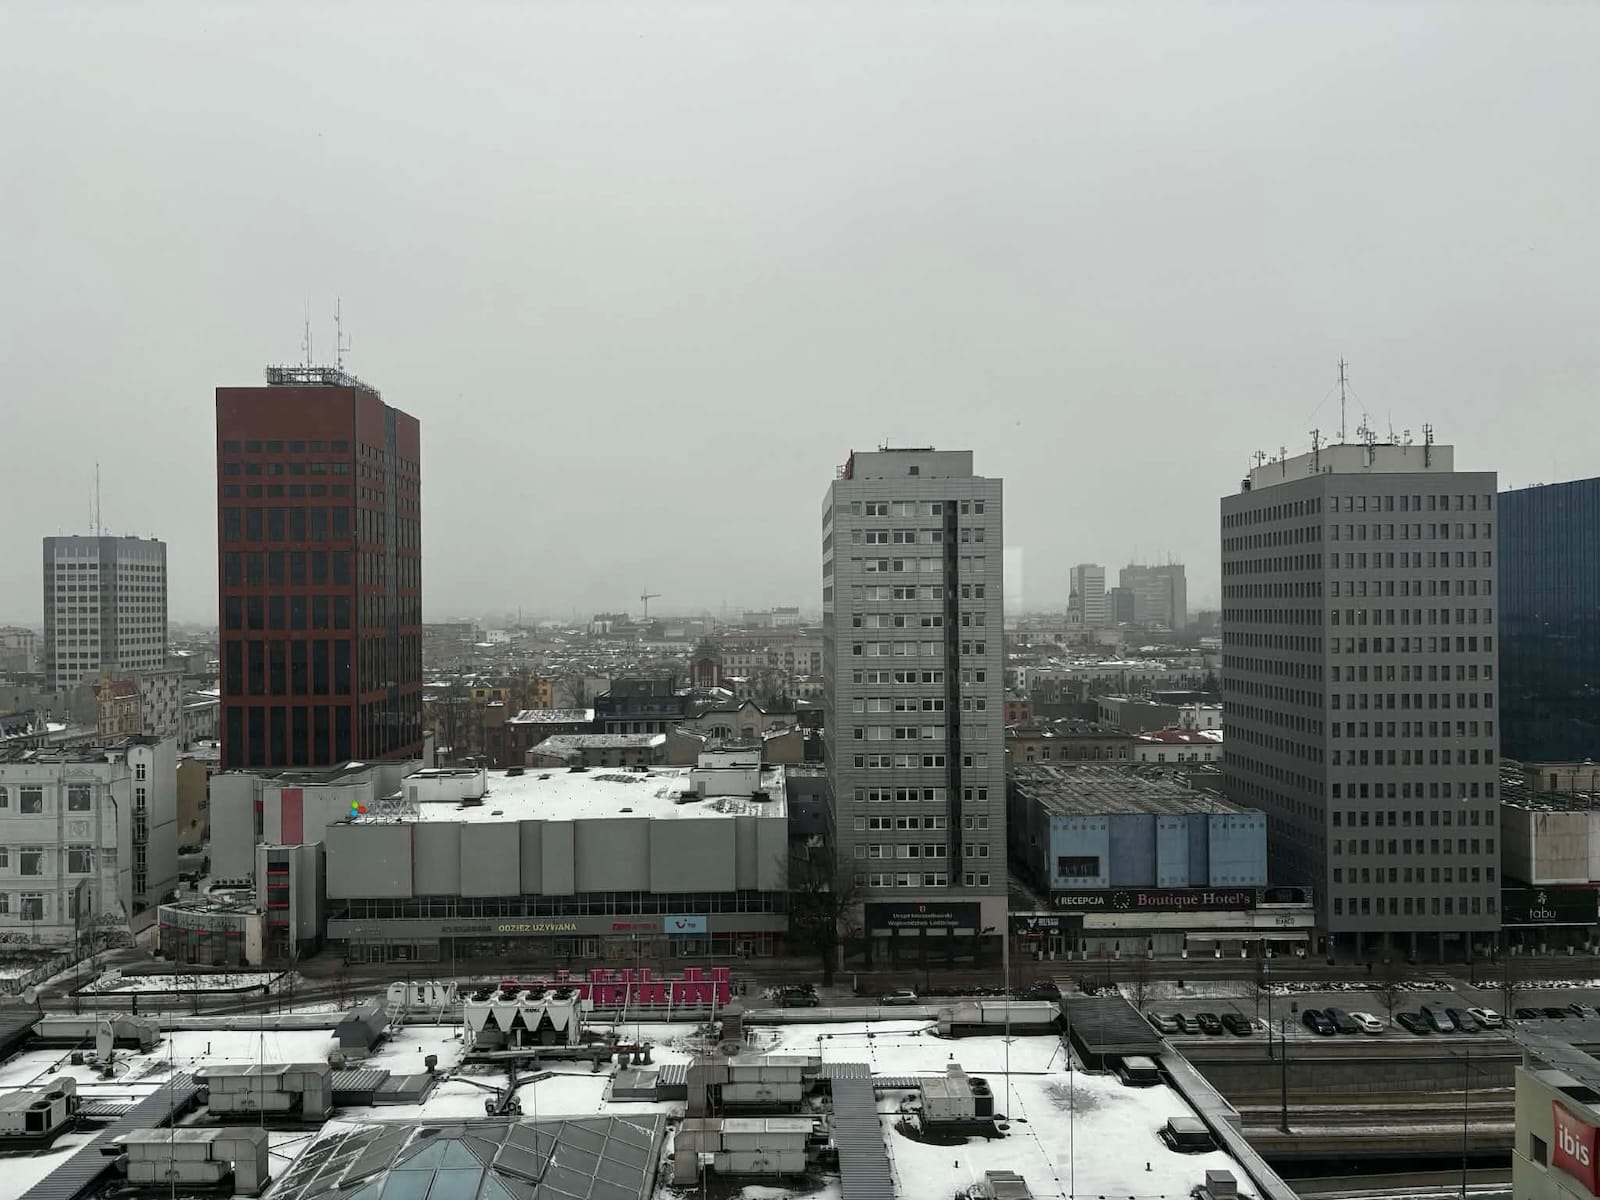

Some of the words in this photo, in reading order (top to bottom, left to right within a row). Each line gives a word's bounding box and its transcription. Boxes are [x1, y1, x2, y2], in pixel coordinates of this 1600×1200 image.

[1061, 896, 1105, 905] RECEPCJA
[1137, 893, 1199, 909] Boutique
[1201, 892, 1250, 905] Hotel's
[1559, 1123, 1590, 1167] ibis
